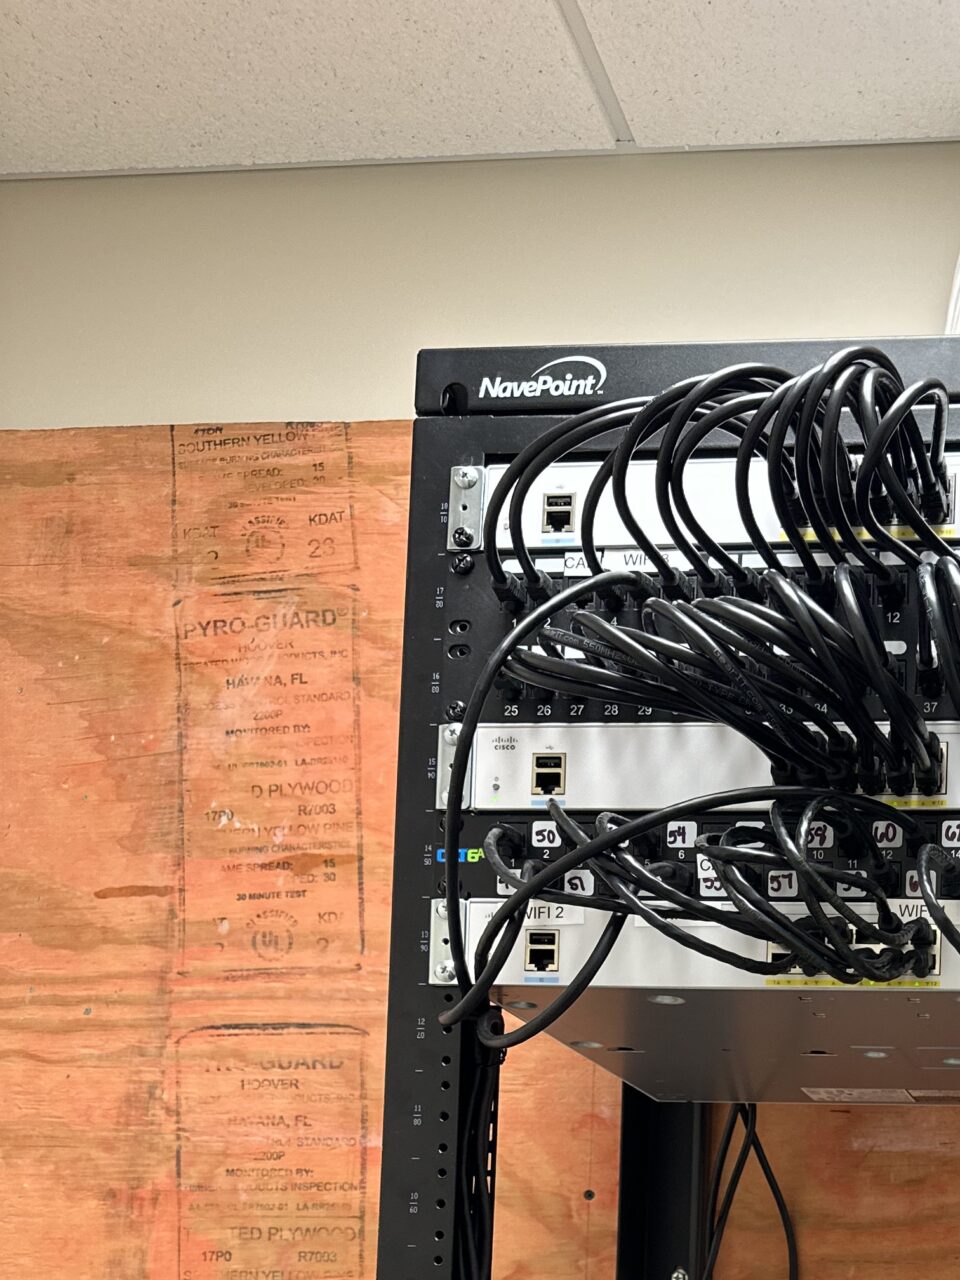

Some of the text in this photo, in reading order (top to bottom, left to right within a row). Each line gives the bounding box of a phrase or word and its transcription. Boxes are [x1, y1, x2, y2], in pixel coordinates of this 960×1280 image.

[479, 373, 597, 399] NavePoint
[312, 462, 325, 473] 15
[308, 510, 346, 527] KDAT
[886, 611, 901, 623] 12
[290, 672, 309, 685] FL
[504, 705, 519, 716] 25
[536, 704, 552, 716] 26
[570, 704, 585, 716] 27
[603, 704, 619, 716] 28
[923, 702, 938, 713] 37
[268, 779, 354, 798] PLYWOOD
[535, 828, 556, 844] 50
[667, 825, 686, 844] 54
[873, 822, 897, 844] 60
[542, 850, 550, 859] 2
[678, 850, 685, 860] 6
[812, 850, 824, 860] 10
[245, 858, 336, 872] SPREAD: 15
[847, 859, 858, 869] 11
[323, 873, 336, 883] 30
[769, 873, 794, 892] 57
[555, 905, 565, 919] 2
[290, 1181, 360, 1192] INSPECTION
[267, 1226, 357, 1242] PLYWOOD
